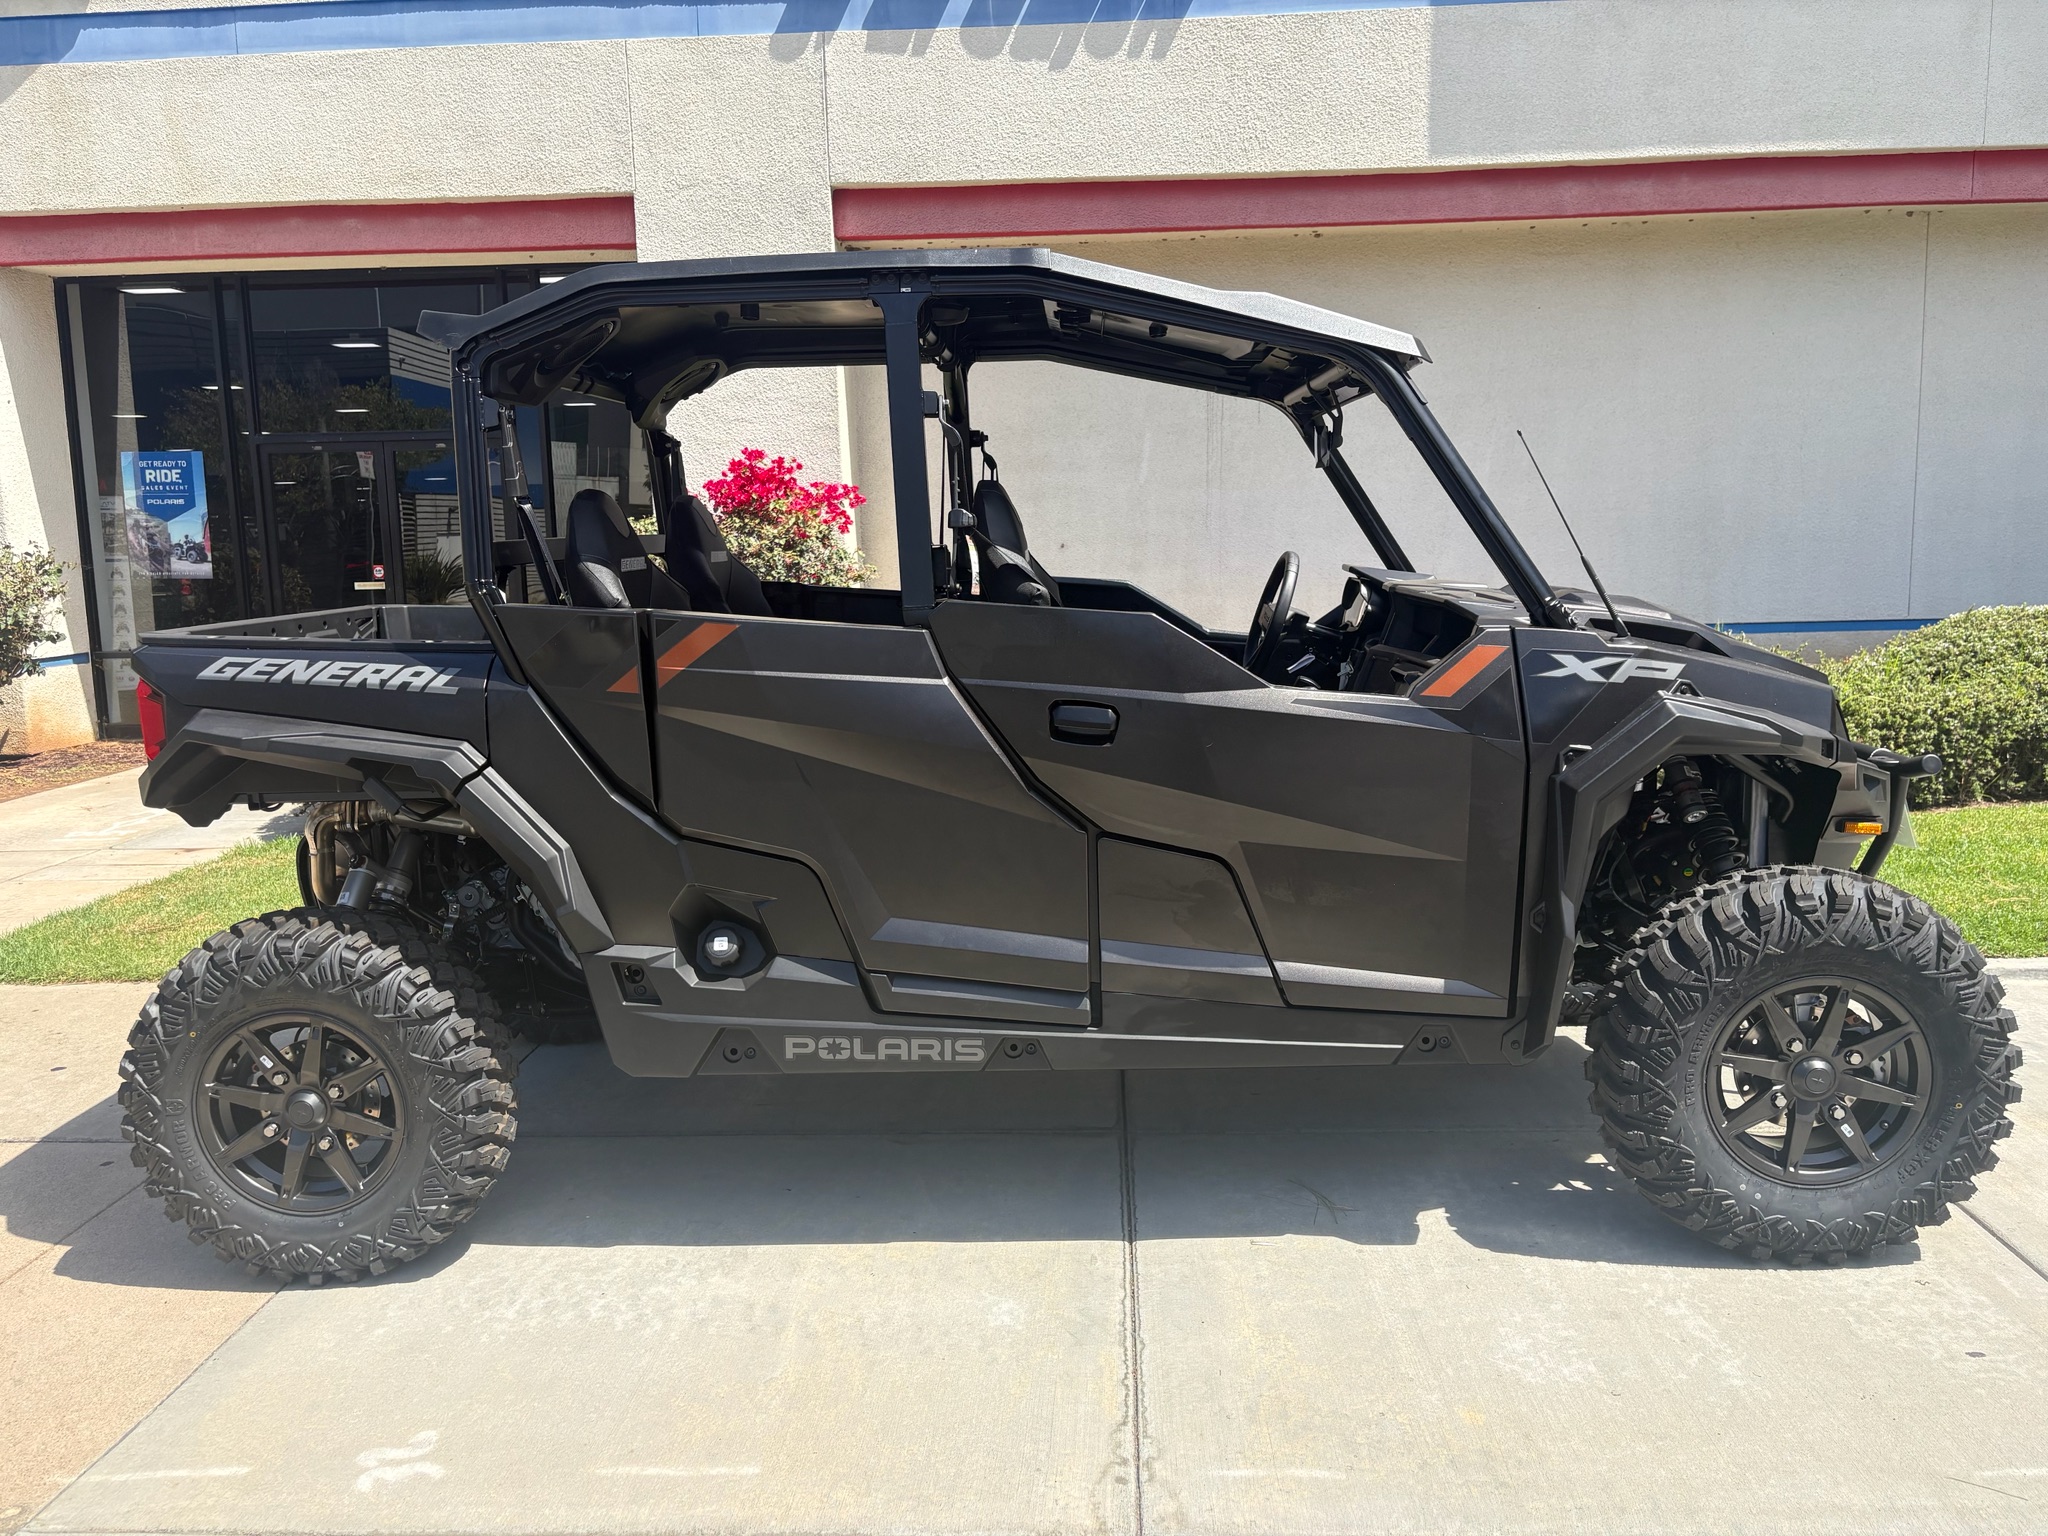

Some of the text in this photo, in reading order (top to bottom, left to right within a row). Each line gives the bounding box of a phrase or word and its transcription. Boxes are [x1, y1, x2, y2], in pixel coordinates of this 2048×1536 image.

[138, 460, 151, 468] GET
[153, 460, 176, 468] READY
[145, 469, 182, 483] RIDE
[196, 656, 462, 695] GENERAL
[1529, 652, 1687, 683] XP
[784, 1037, 986, 1062] POLARIS
